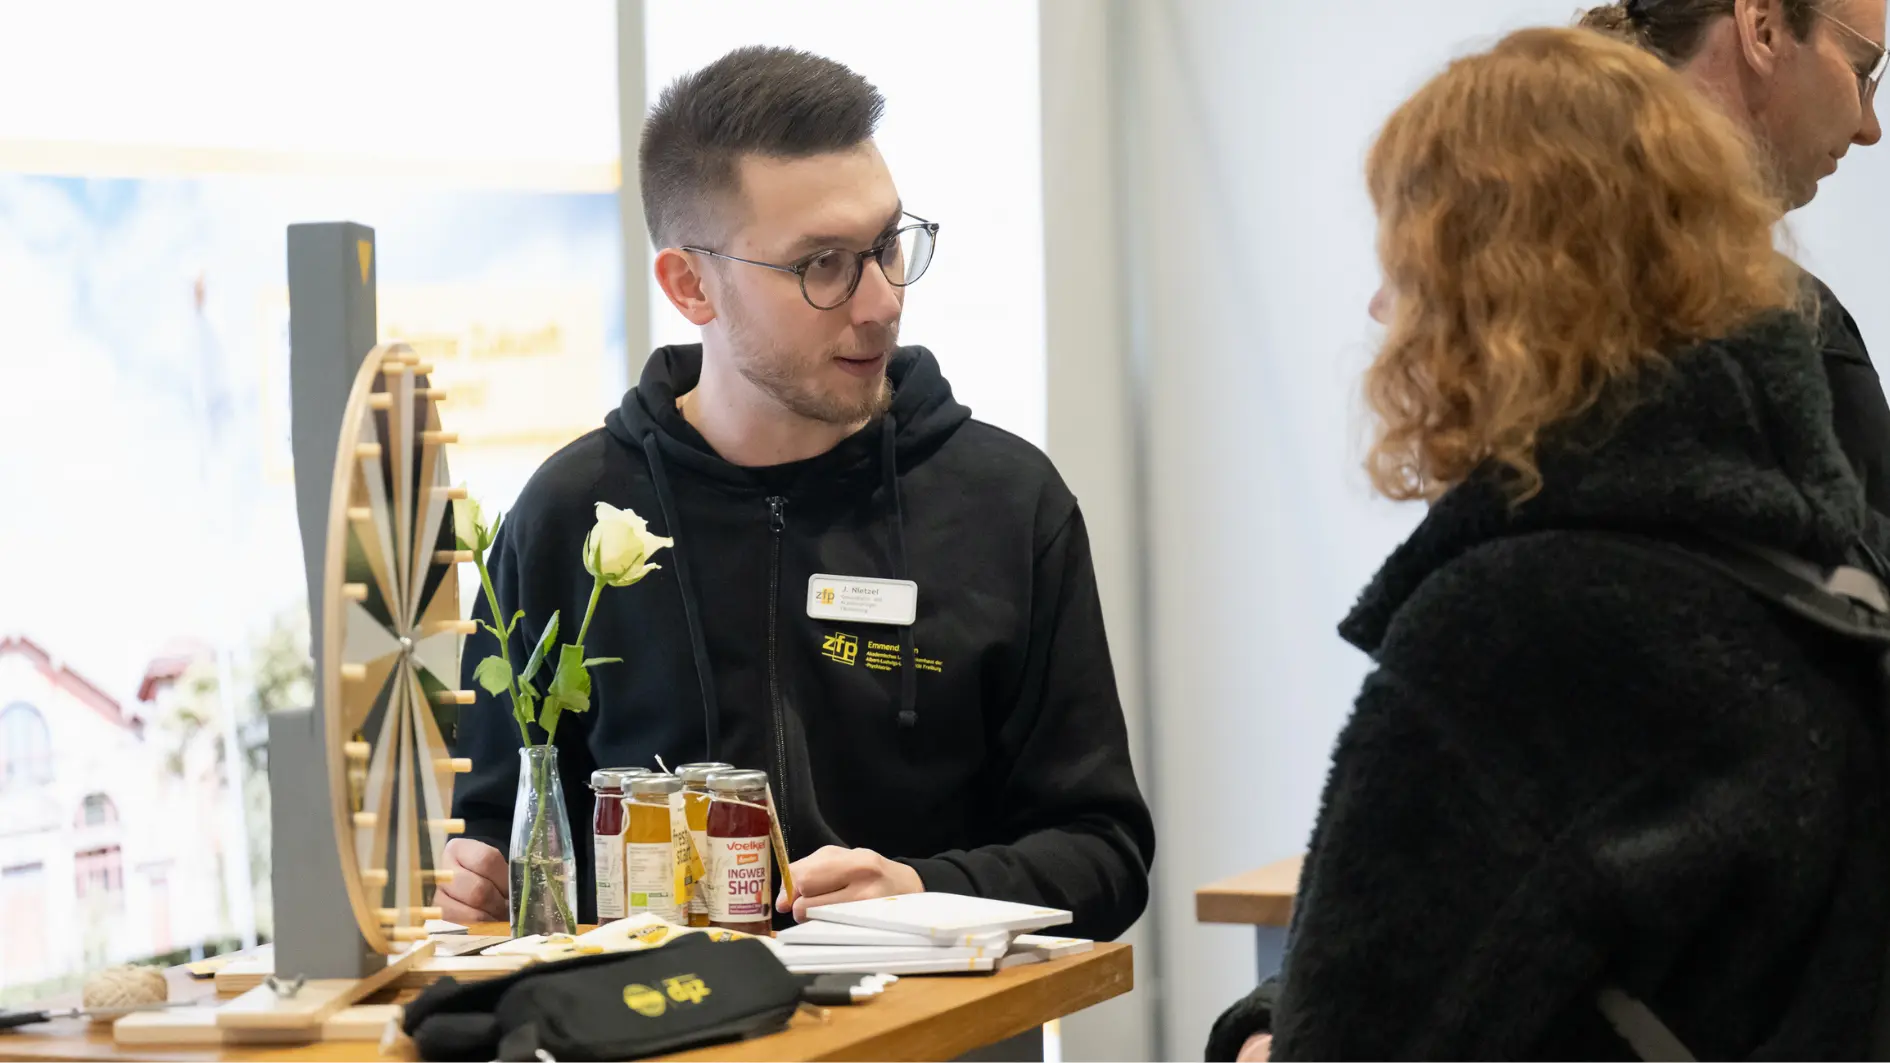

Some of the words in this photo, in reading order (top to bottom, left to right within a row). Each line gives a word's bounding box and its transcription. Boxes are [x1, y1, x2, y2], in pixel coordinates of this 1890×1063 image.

[816, 588, 835, 603] zfp
[842, 585, 848, 593] J.
[851, 586, 879, 595] Nietzel
[822, 635, 858, 660] zfp
[727, 867, 766, 879] INGWER
[728, 879, 766, 895] SHOT
